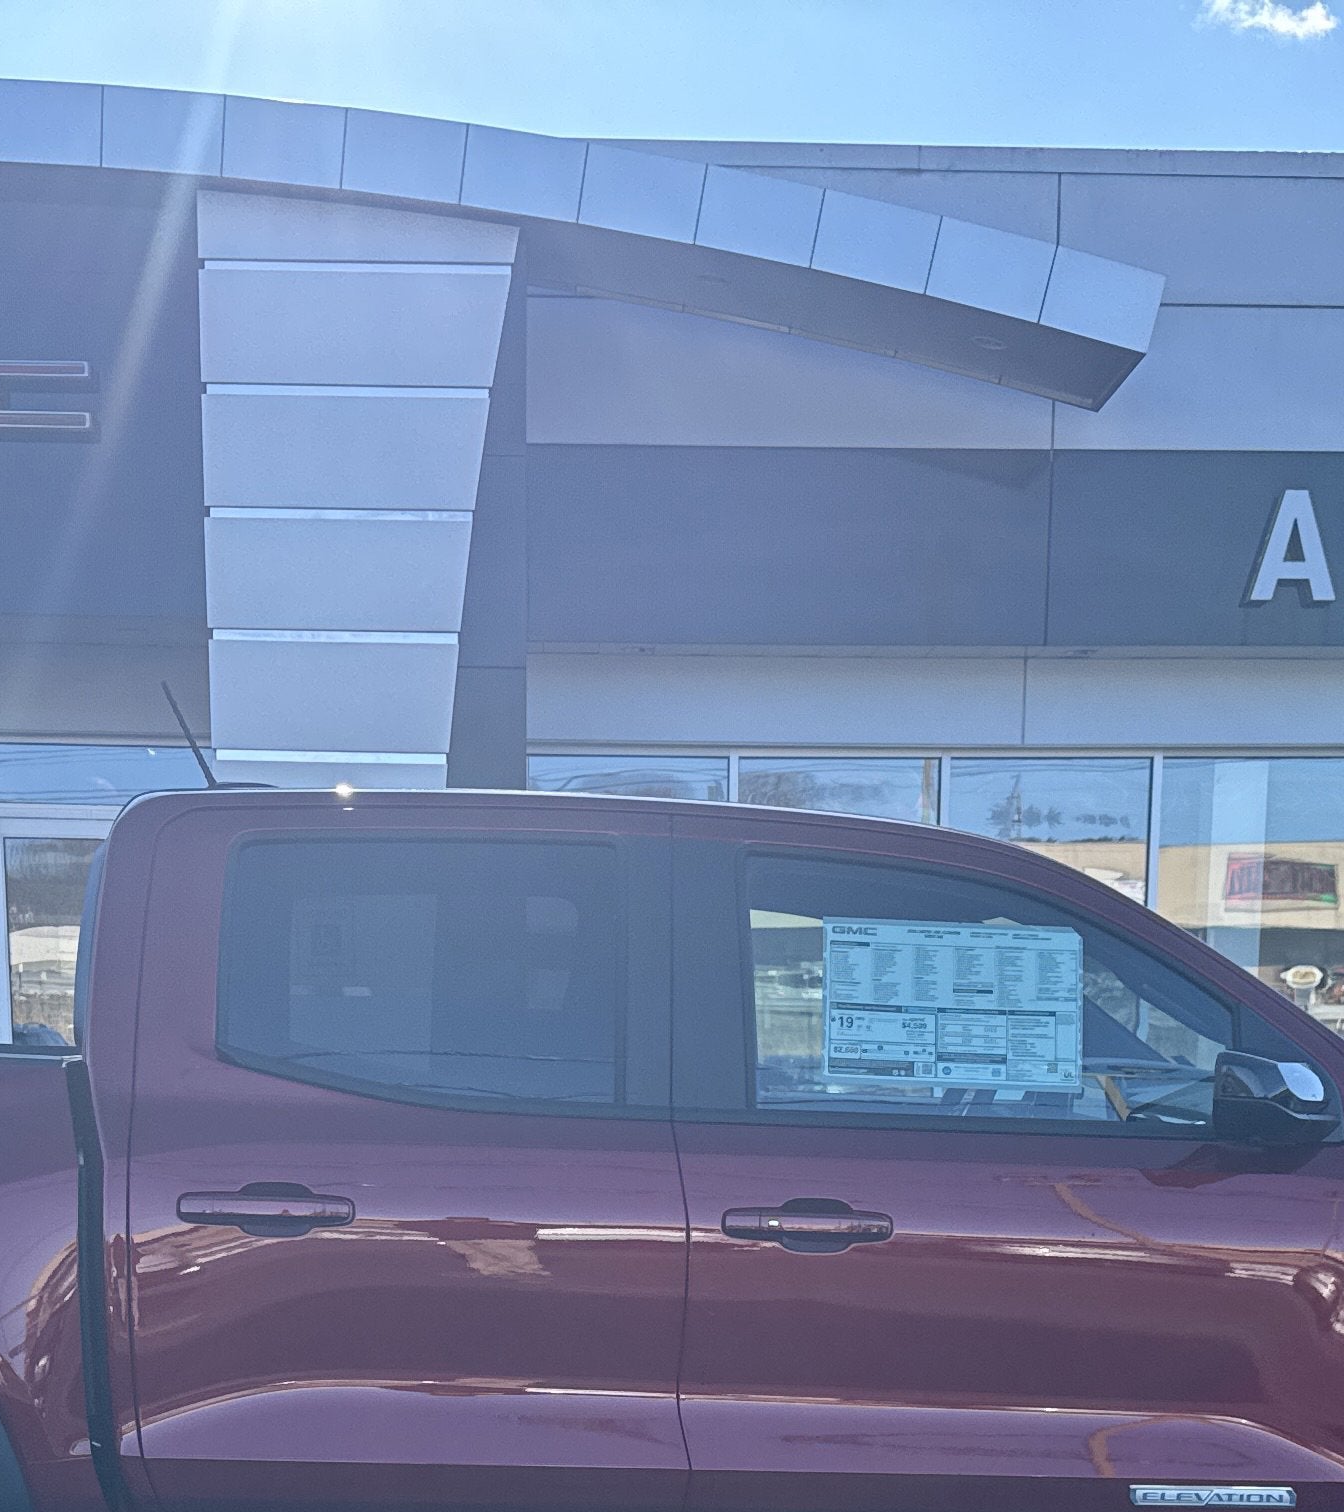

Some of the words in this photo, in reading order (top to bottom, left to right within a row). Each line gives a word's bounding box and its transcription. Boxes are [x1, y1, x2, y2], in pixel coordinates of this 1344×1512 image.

[831, 925, 877, 937] GMC
[838, 1016, 854, 1029] 19
[1142, 1492, 1284, 1504] ELEVATION
